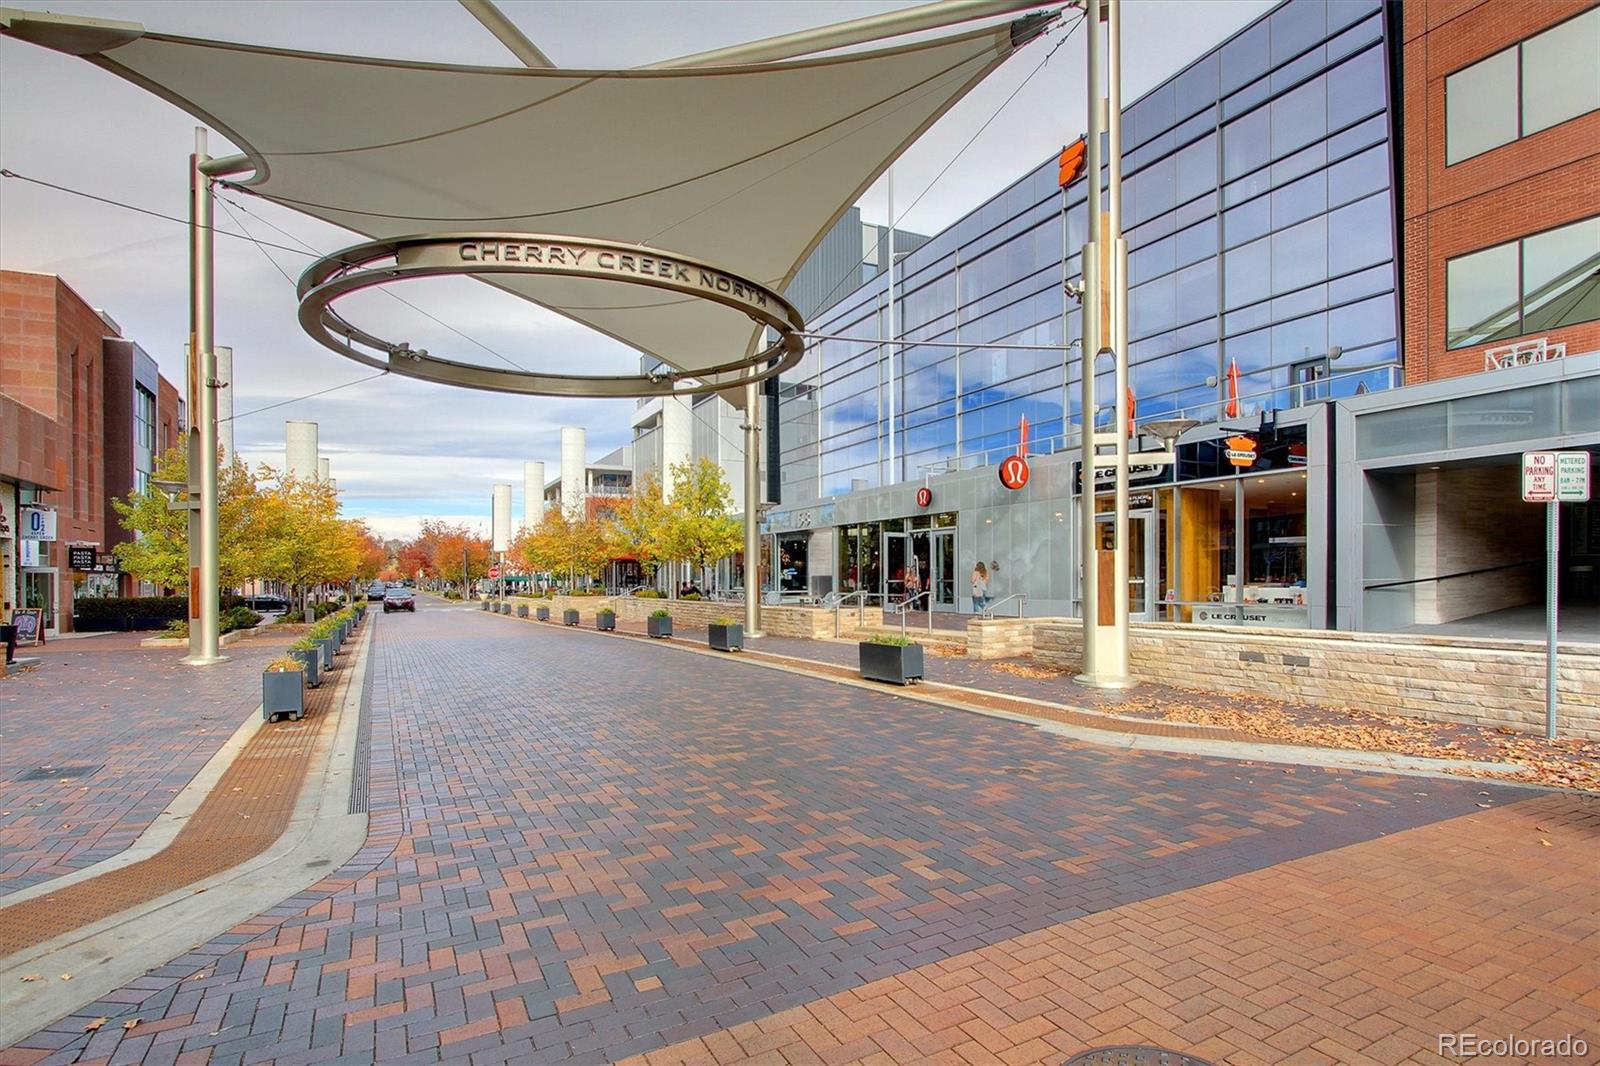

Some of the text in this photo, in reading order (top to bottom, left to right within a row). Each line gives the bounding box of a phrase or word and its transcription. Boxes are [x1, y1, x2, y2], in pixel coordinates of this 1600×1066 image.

[458, 242, 768, 308] CHERRY CREEK NORTH
[1534, 456, 1546, 465] NO
[1525, 466, 1554, 476] PARKING
